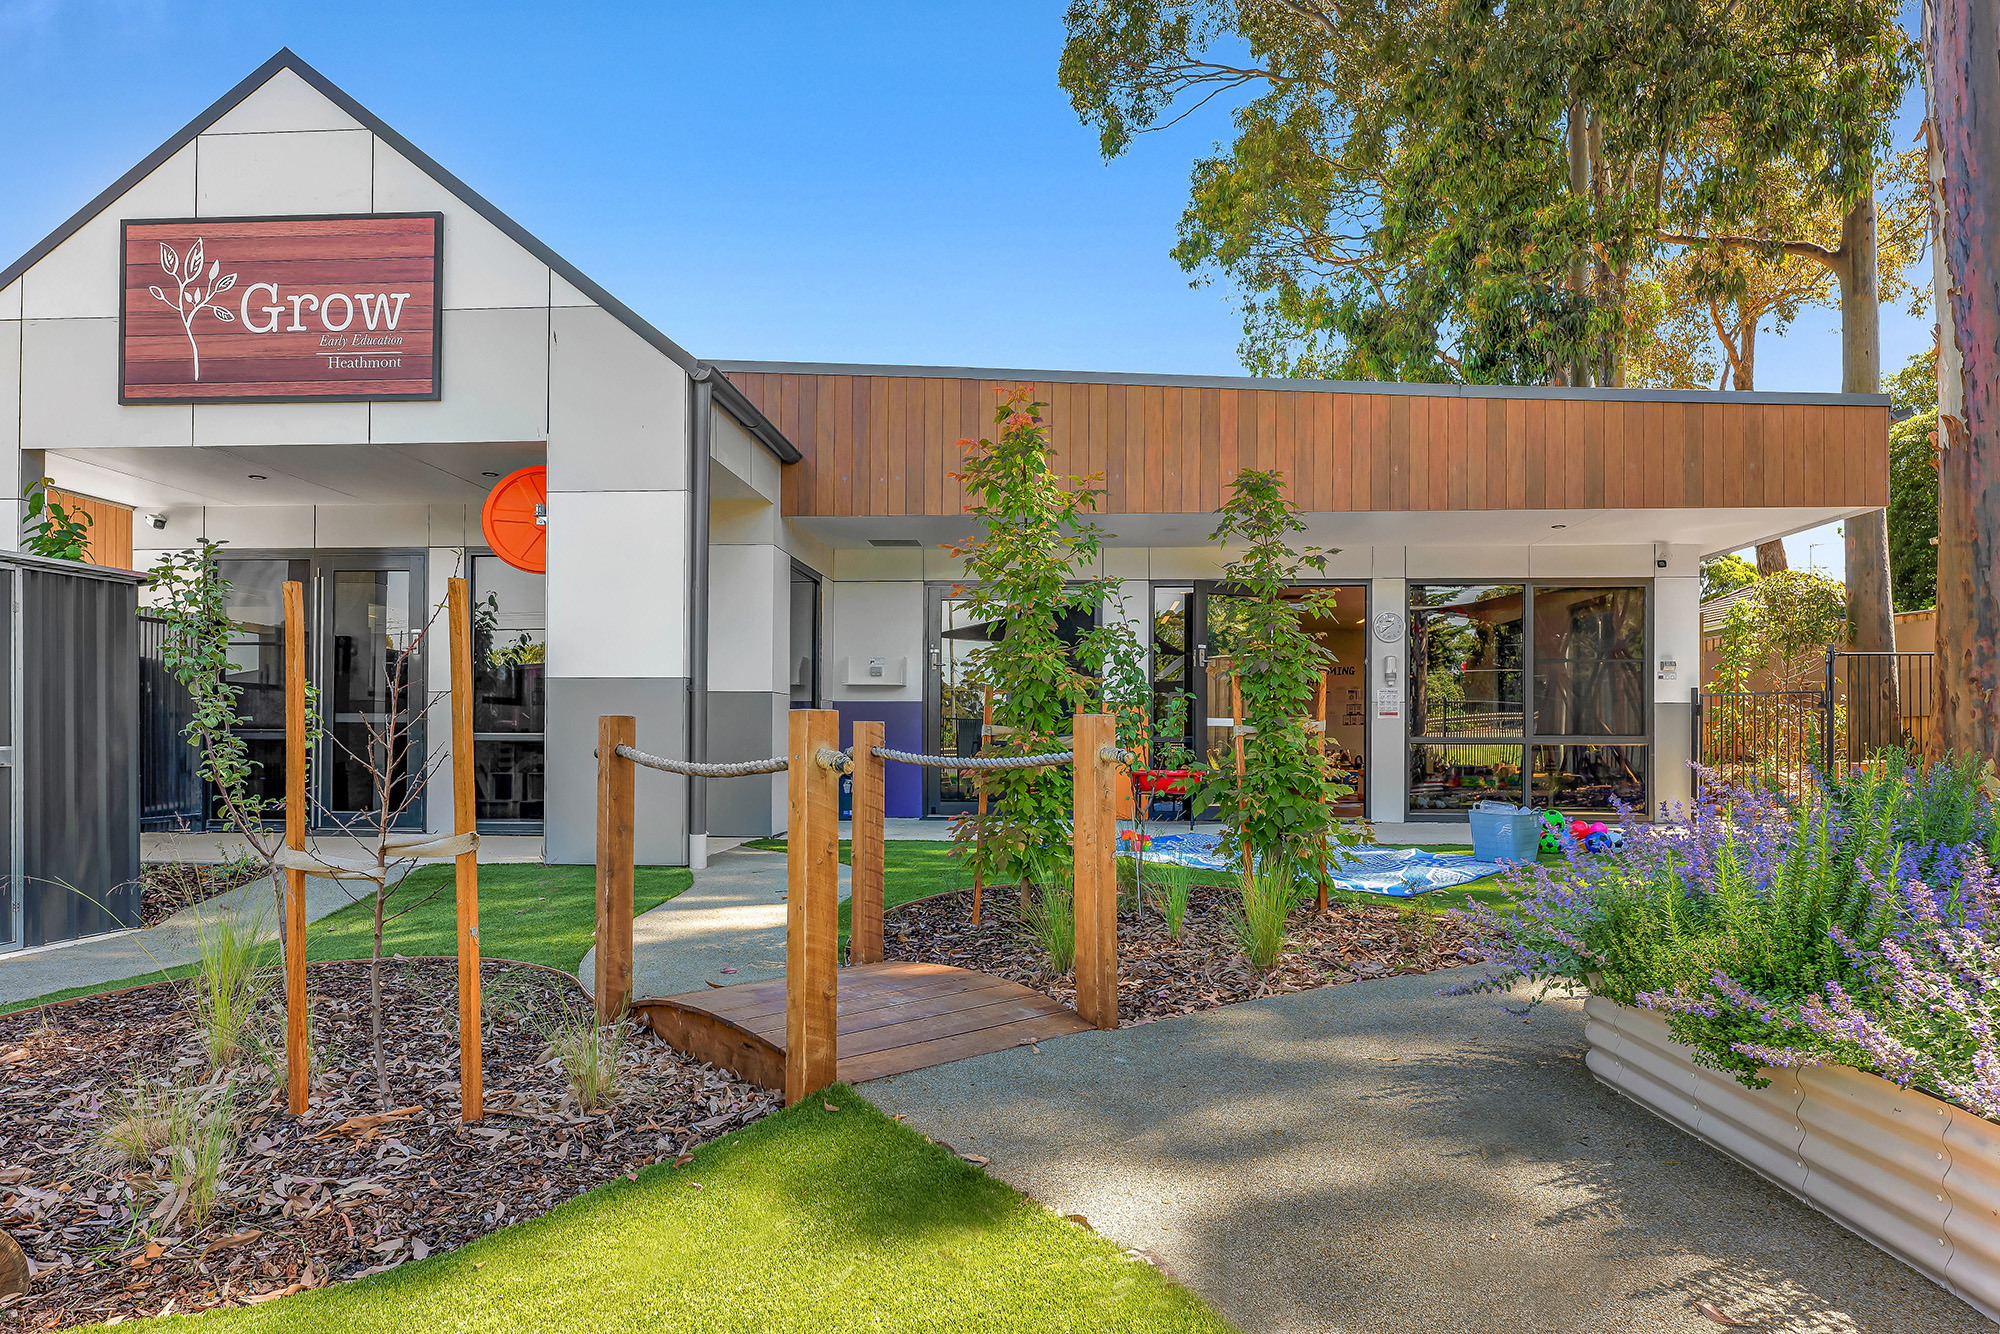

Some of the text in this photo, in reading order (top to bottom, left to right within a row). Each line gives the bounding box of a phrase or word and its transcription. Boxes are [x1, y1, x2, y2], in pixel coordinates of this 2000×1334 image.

[240, 282, 411, 333] Grow
[319, 333, 403, 350] Early Education
[327, 356, 402, 369] Heathmont
